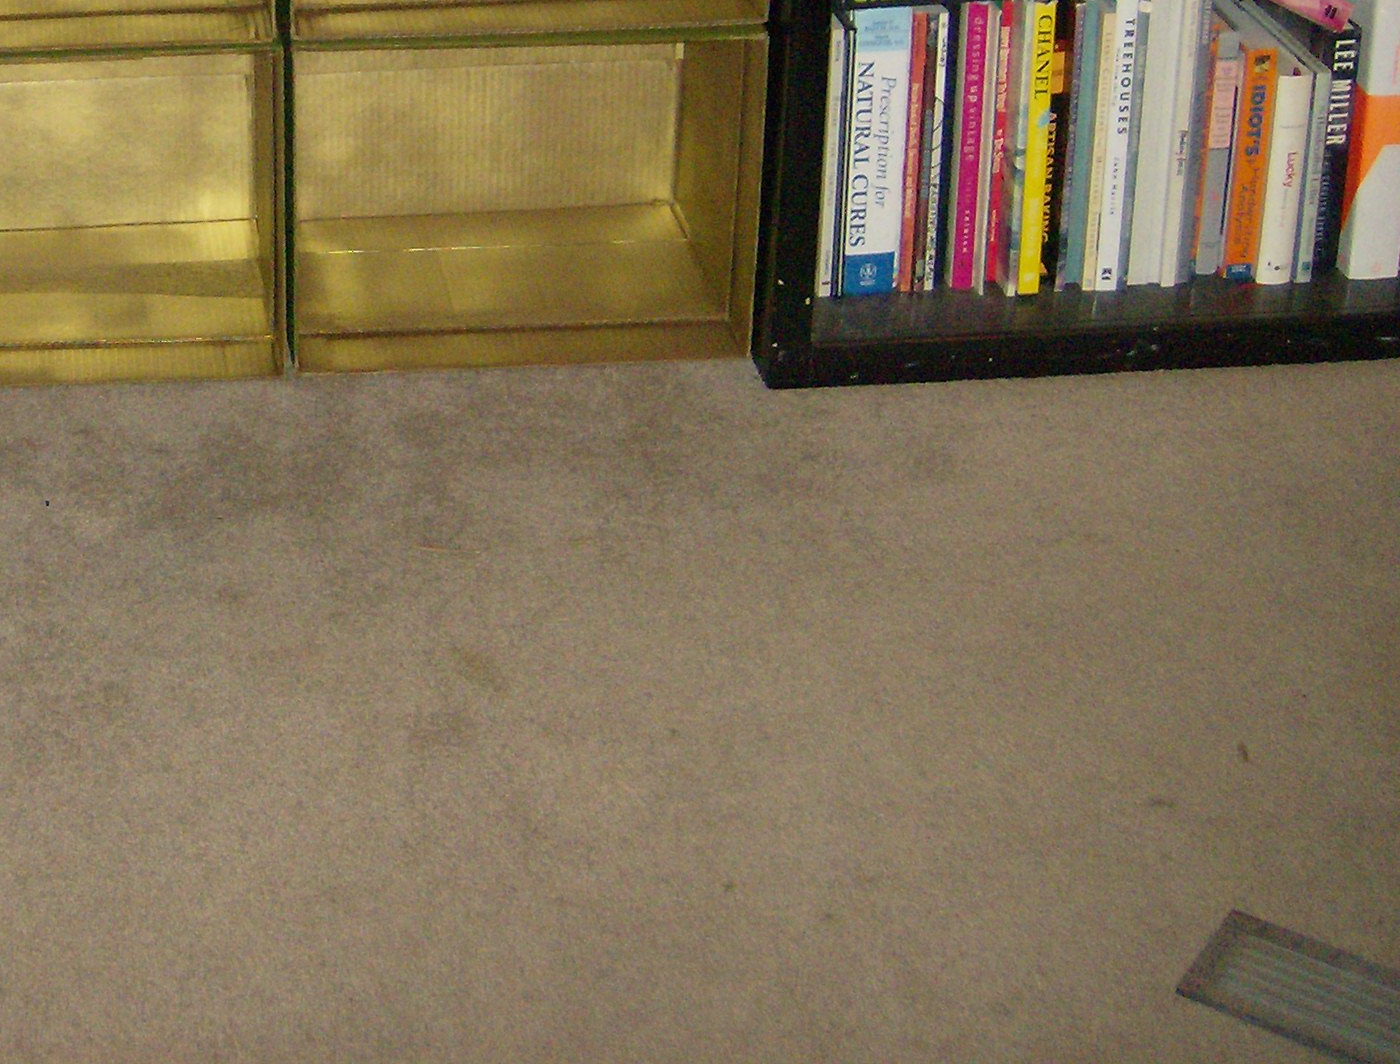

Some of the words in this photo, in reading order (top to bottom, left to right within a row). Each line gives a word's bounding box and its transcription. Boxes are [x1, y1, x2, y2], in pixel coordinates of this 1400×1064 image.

[966, 15, 985, 81] dressing
[1030, 13, 1055, 101] CHANEL
[1115, 16, 1136, 136] TREEHOUSES
[1331, 36, 1357, 74] LEE
[850, 60, 876, 171] NATURAL
[868, 75, 898, 180] Prescription
[966, 84, 979, 103] up
[1243, 83, 1267, 158] IDIOT'S
[1324, 77, 1353, 147] MILLER
[962, 105, 979, 162] vintage
[870, 183, 889, 209] for
[1281, 150, 1298, 188] Lucky
[846, 172, 869, 249] CURES
